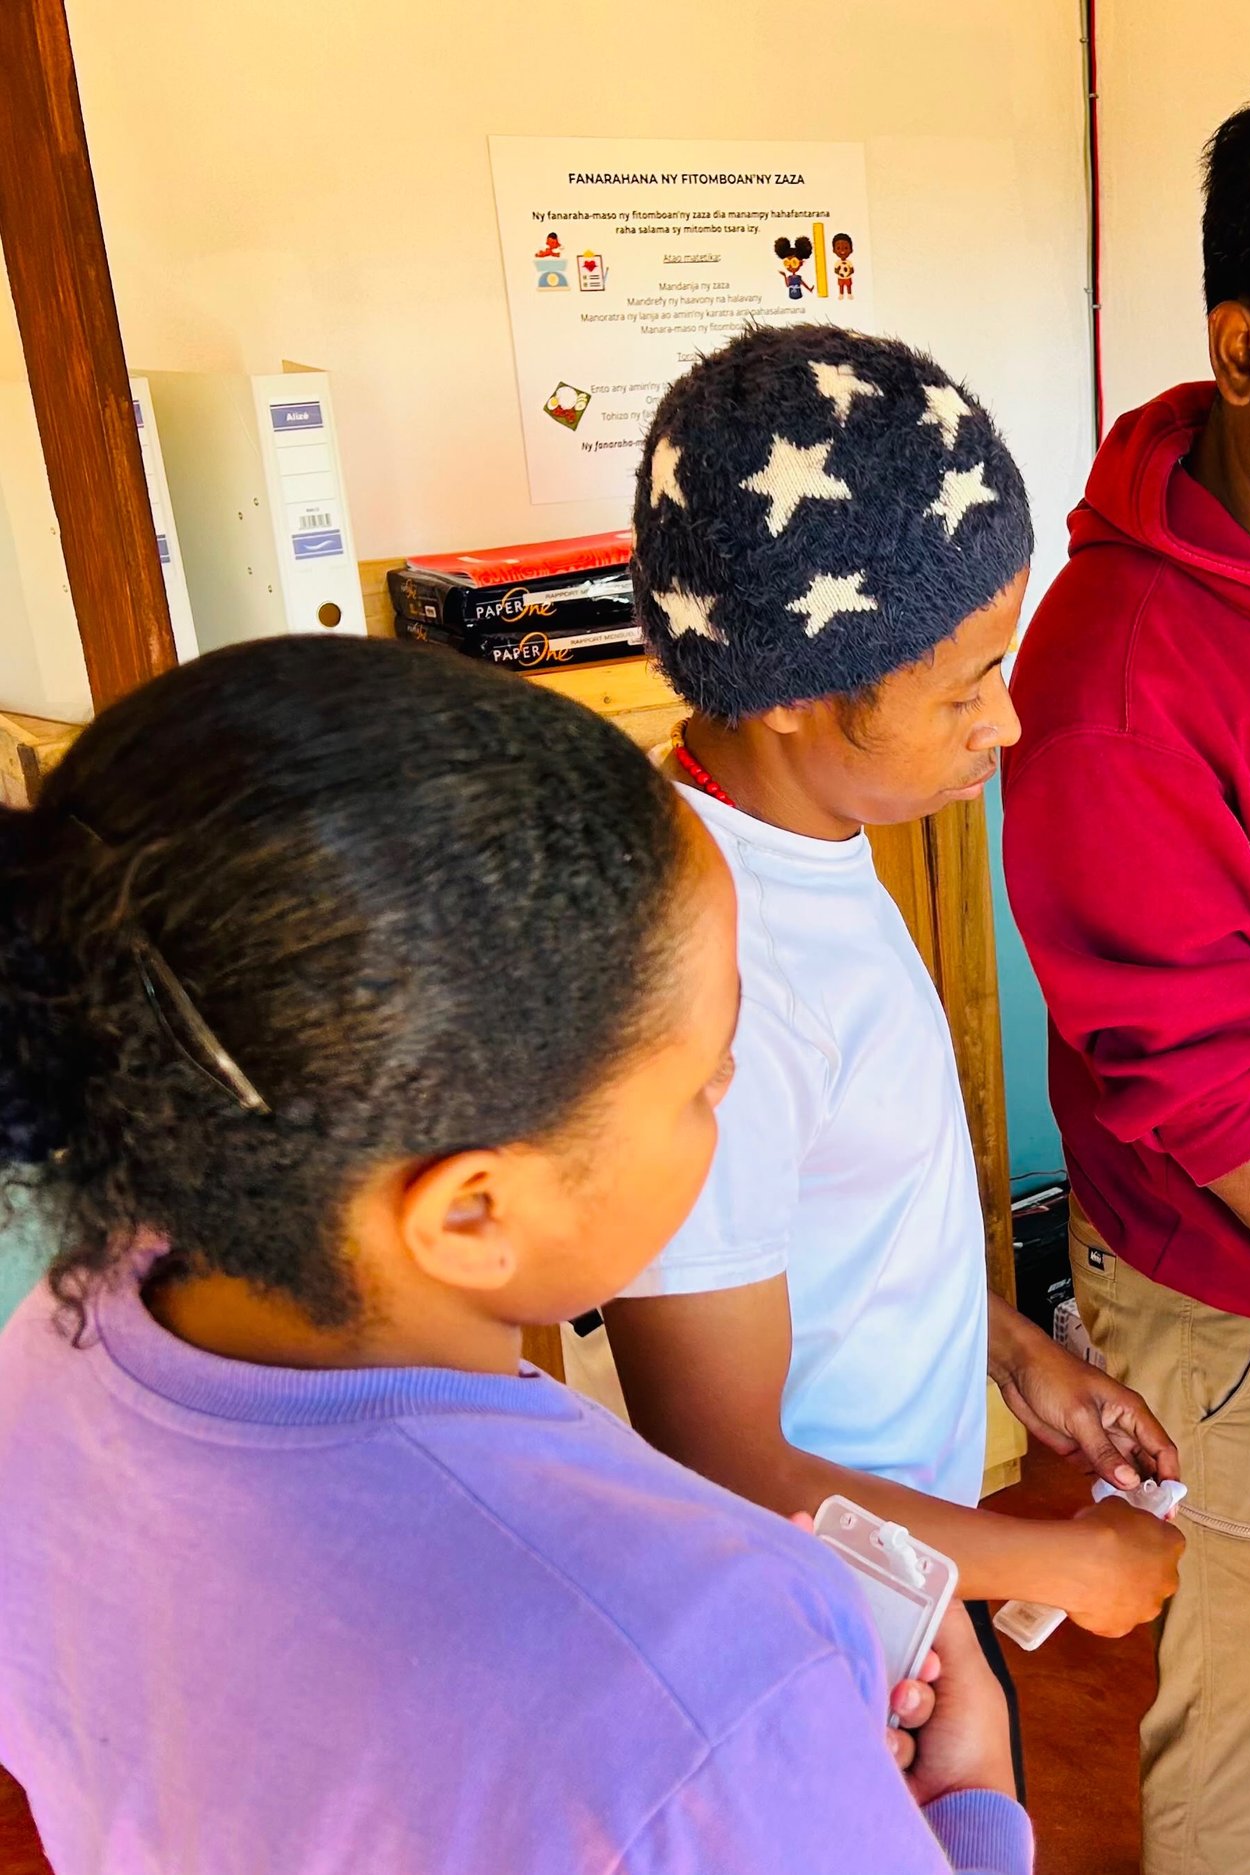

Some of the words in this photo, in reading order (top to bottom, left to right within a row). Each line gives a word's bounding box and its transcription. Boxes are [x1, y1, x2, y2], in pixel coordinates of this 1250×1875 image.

[568, 173, 658, 185] FANARAHANA
[661, 173, 678, 185] NY
[681, 173, 772, 185] FITOMBOAN'NY
[774, 174, 805, 185] ZAZA
[532, 211, 546, 222] Ny
[547, 210, 617, 221] fanaraha-maso
[619, 211, 630, 222] ny
[632, 210, 690, 221] fitomboan'ny
[692, 210, 711, 219] zaza
[713, 209, 726, 219] dia
[728, 210, 769, 221] manampy
[770, 209, 830, 218] hahafantarana
[615, 225, 637, 234] raha
[638, 225, 670, 234] salama
[672, 226, 682, 236] sy
[683, 224, 722, 233] mitombo
[724, 224, 746, 233] tsara
[700, 282, 711, 292] ny
[712, 281, 730, 290] zaza
[581, 441, 593, 452] Ny
